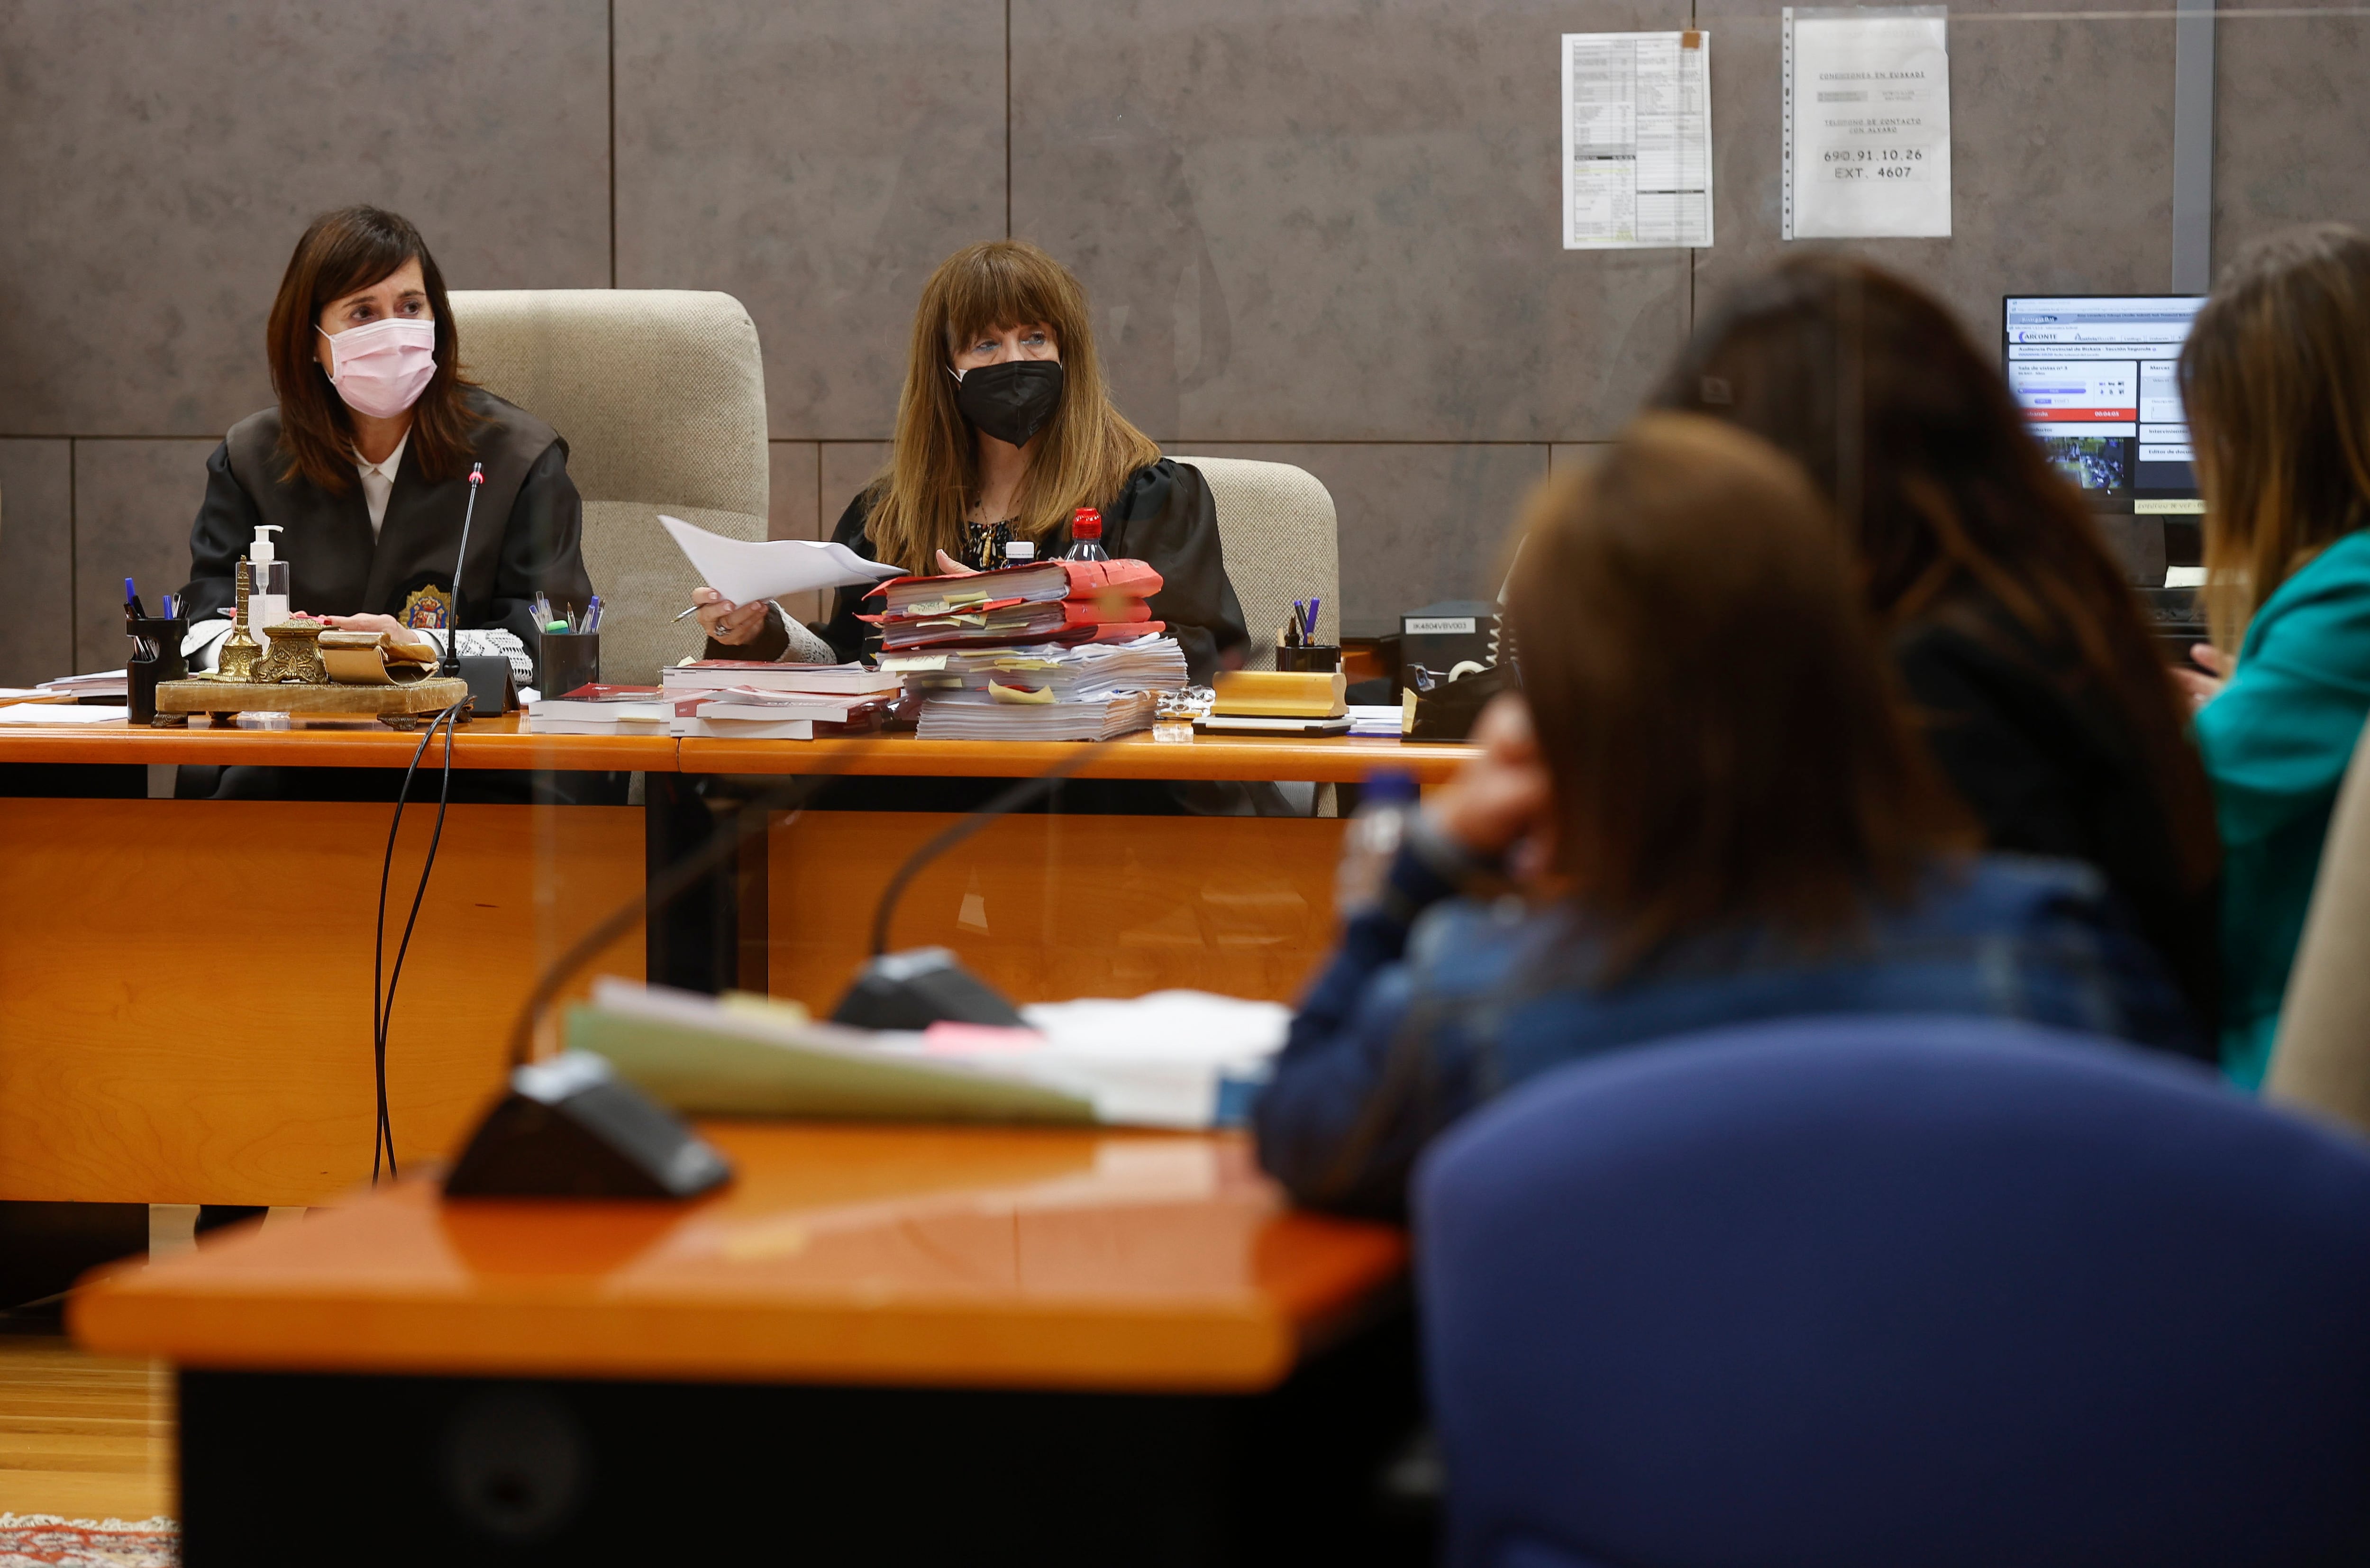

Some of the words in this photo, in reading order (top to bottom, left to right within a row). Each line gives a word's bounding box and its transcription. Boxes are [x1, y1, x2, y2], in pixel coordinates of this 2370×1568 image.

[1889, 71, 1925, 79] EUSKADI
[1824, 150, 1923, 162] 690.91.10.26
[1835, 167, 1869, 179] EXT.
[1878, 167, 1912, 178] 4607
